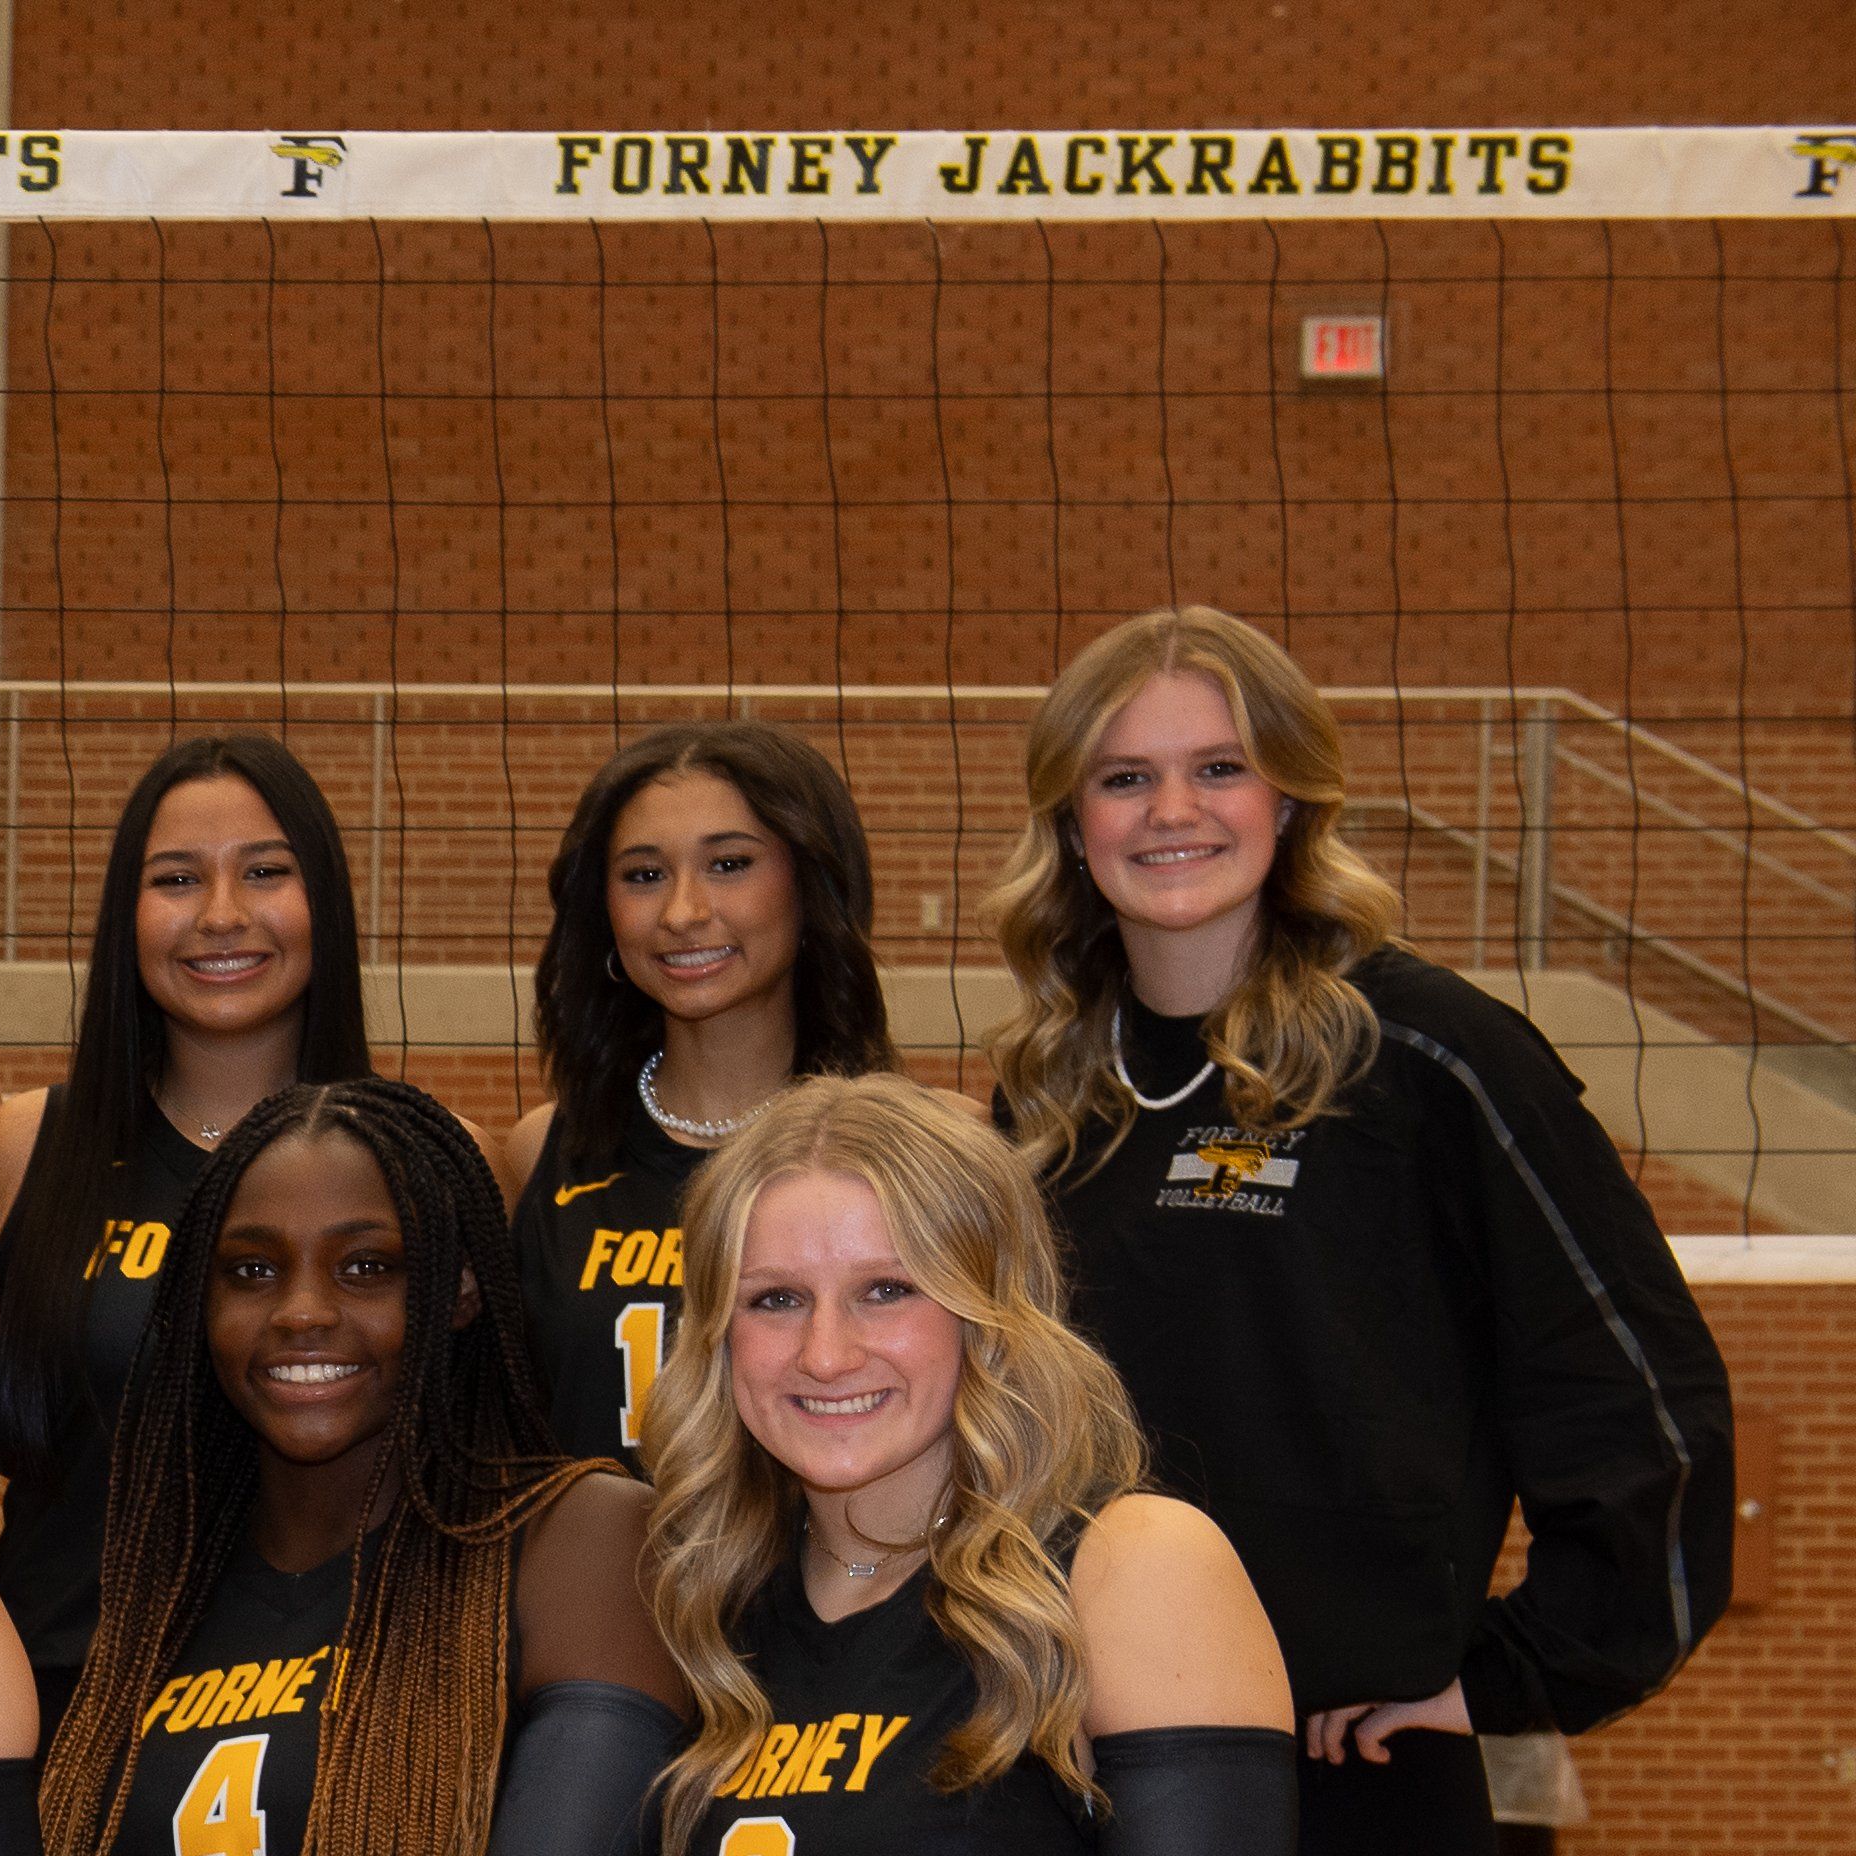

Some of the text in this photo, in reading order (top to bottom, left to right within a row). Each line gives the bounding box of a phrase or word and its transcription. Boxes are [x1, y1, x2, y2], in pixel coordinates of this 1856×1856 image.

[555, 134, 1575, 197] FORNEY JACKRABBITS
[579, 1227, 684, 1291] FOR
[615, 1302, 684, 1448] 1
